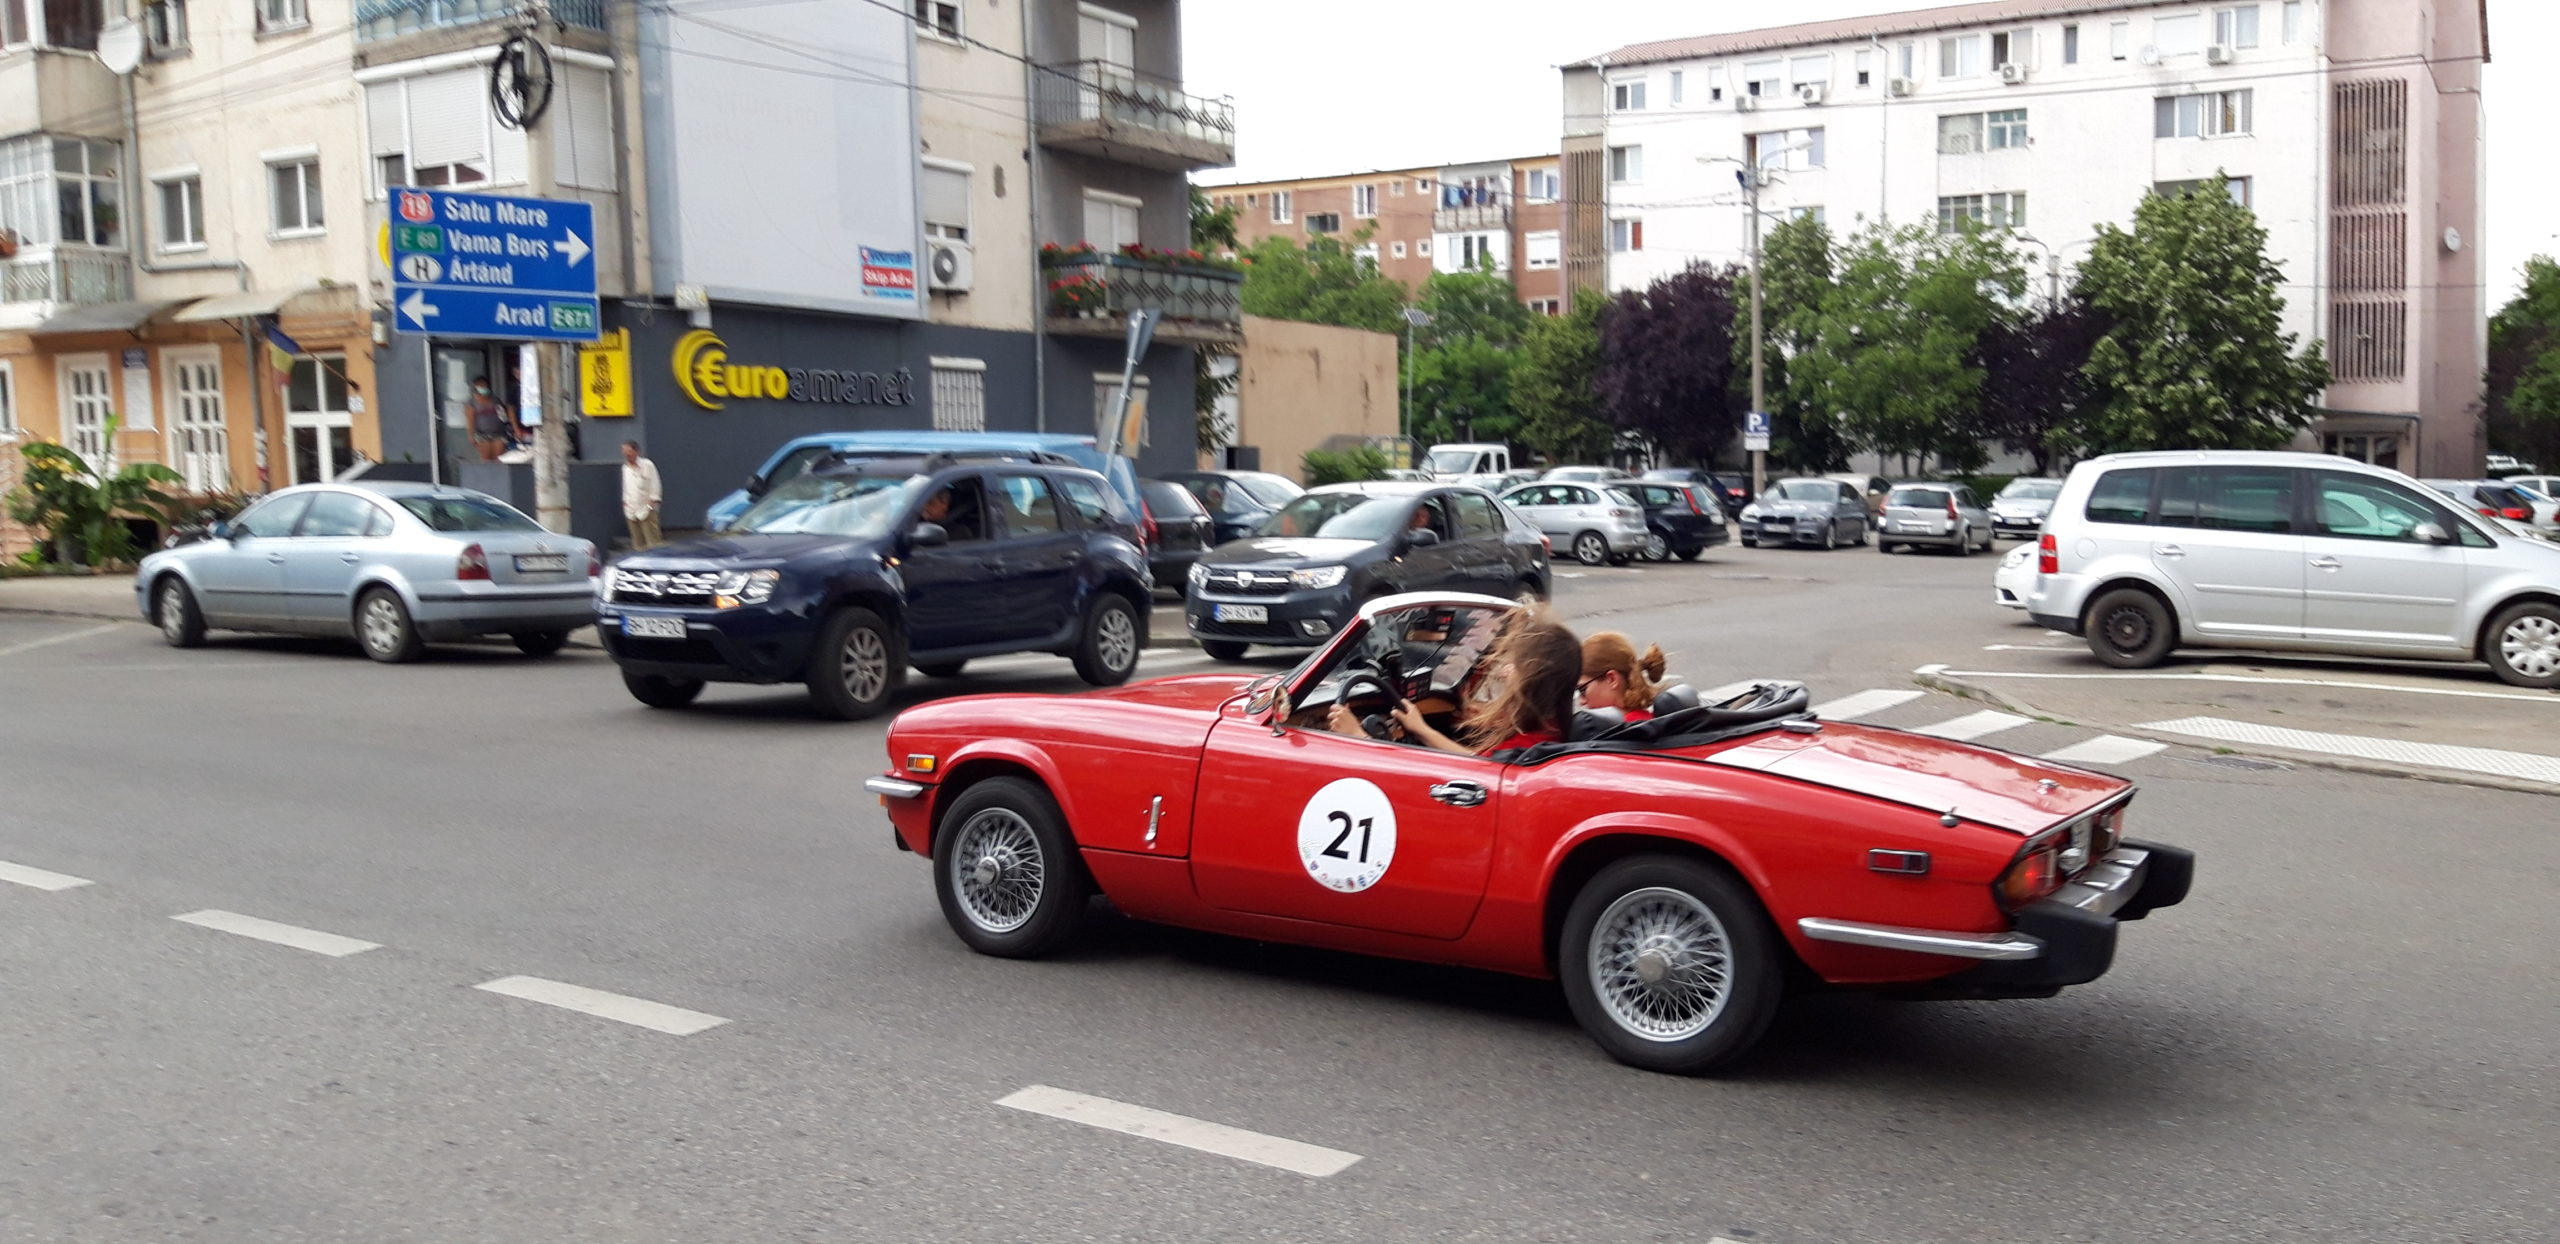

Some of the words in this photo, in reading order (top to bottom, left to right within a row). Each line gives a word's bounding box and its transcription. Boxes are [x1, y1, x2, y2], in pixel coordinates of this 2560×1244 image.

[406, 197, 427, 217] 19
[445, 197, 492, 222] Satu
[496, 202, 548, 227] Mare
[400, 228, 413, 244] E
[417, 230, 439, 246] 60
[448, 229, 502, 254] Vama
[414, 258, 431, 281] H
[495, 303, 546, 327] Arad
[552, 308, 593, 329] E671
[1321, 811, 1373, 863] 21
